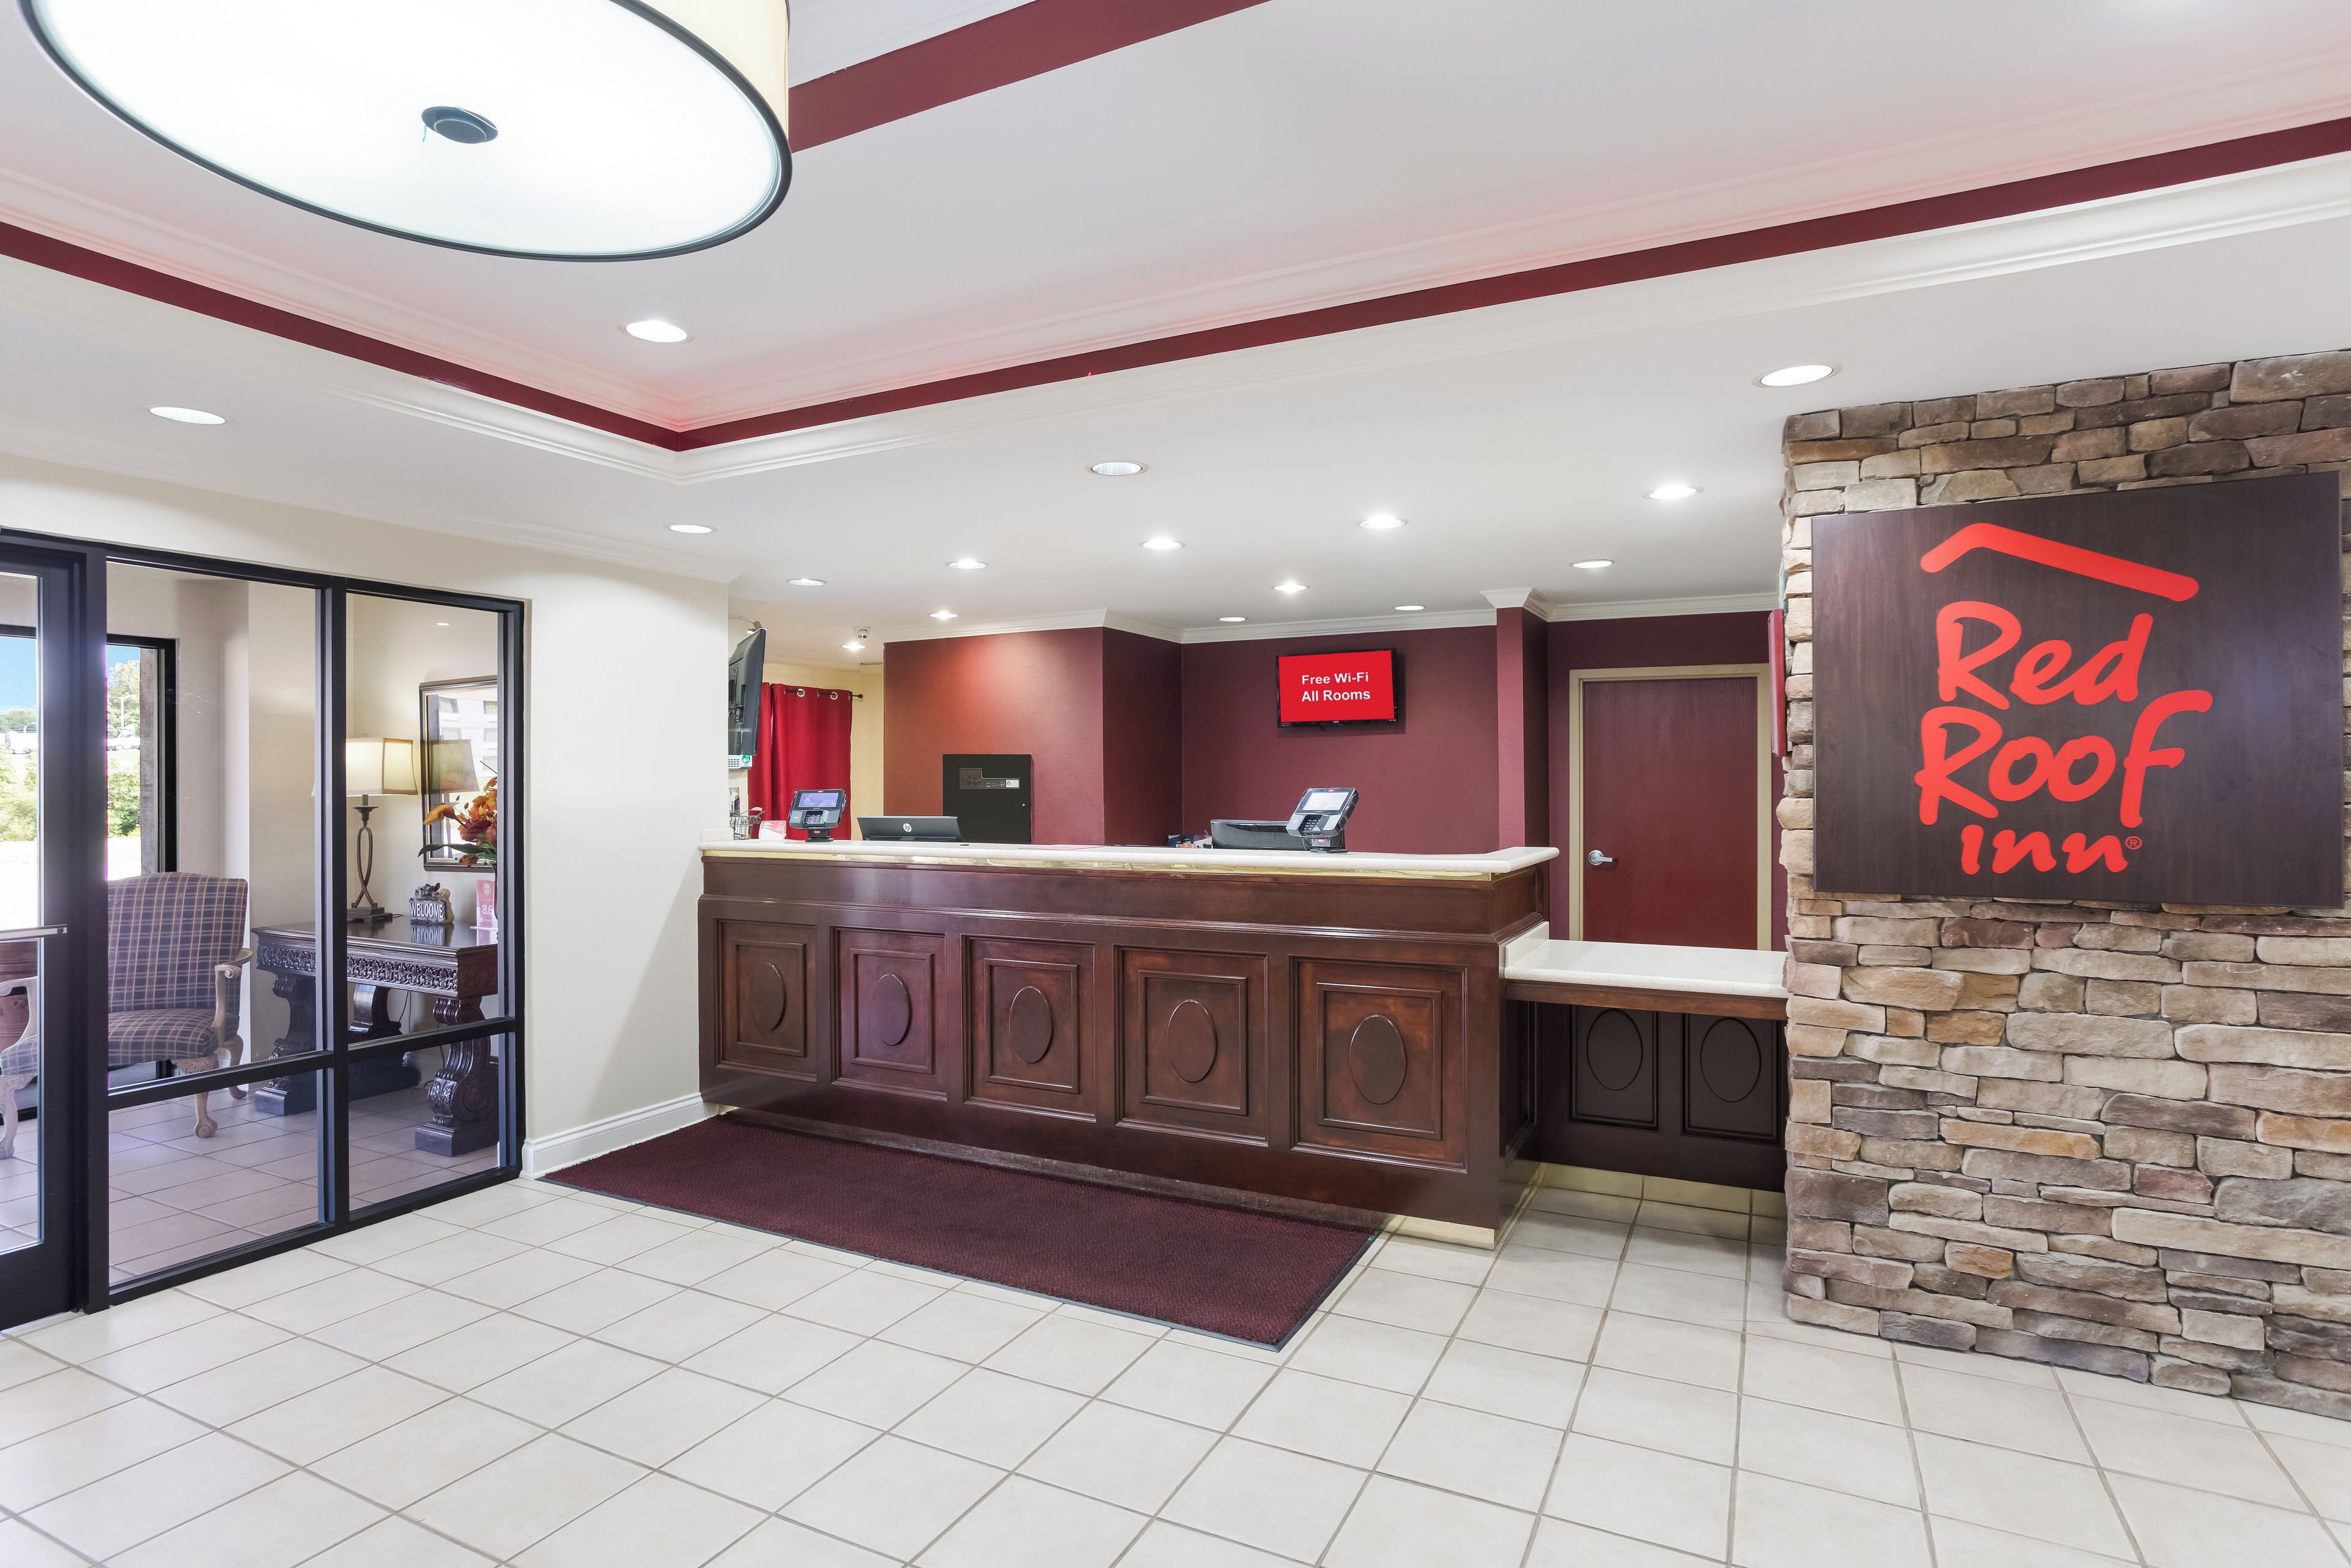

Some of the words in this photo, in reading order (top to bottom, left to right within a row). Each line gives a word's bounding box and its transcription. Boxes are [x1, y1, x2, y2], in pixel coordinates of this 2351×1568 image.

[1936, 601, 2153, 710] Red
[1302, 675, 1330, 685] Free
[1334, 672, 1369, 683] Wi-Fi
[1302, 691, 1319, 702] All
[1323, 690, 1371, 701] Rooms
[1914, 689, 2213, 828] Roof
[904, 823, 911, 833] hp
[410, 902, 444, 918] WELCOME
